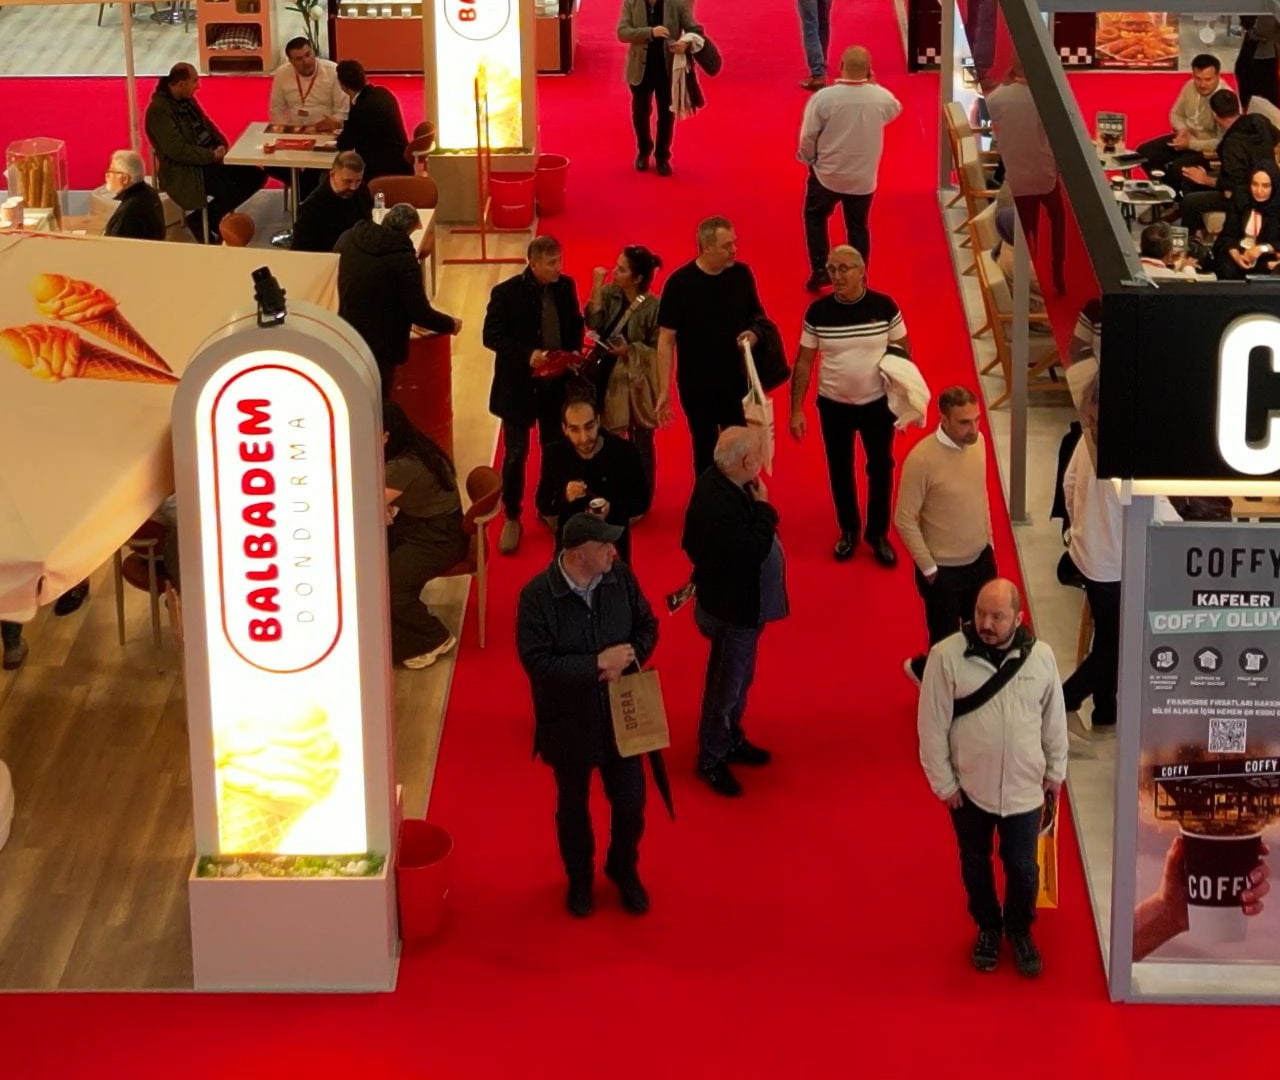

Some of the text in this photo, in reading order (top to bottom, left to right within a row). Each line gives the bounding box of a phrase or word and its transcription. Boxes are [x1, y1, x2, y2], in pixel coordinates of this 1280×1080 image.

[237, 398, 282, 643] BALBADEM
[288, 415, 315, 624] DONDURMA
[1197, 593, 1271, 607] KAFELER
[1154, 612, 1221, 630] COFFY
[1161, 765, 1190, 778] COFFY
[1245, 759, 1278, 773] COFFY
